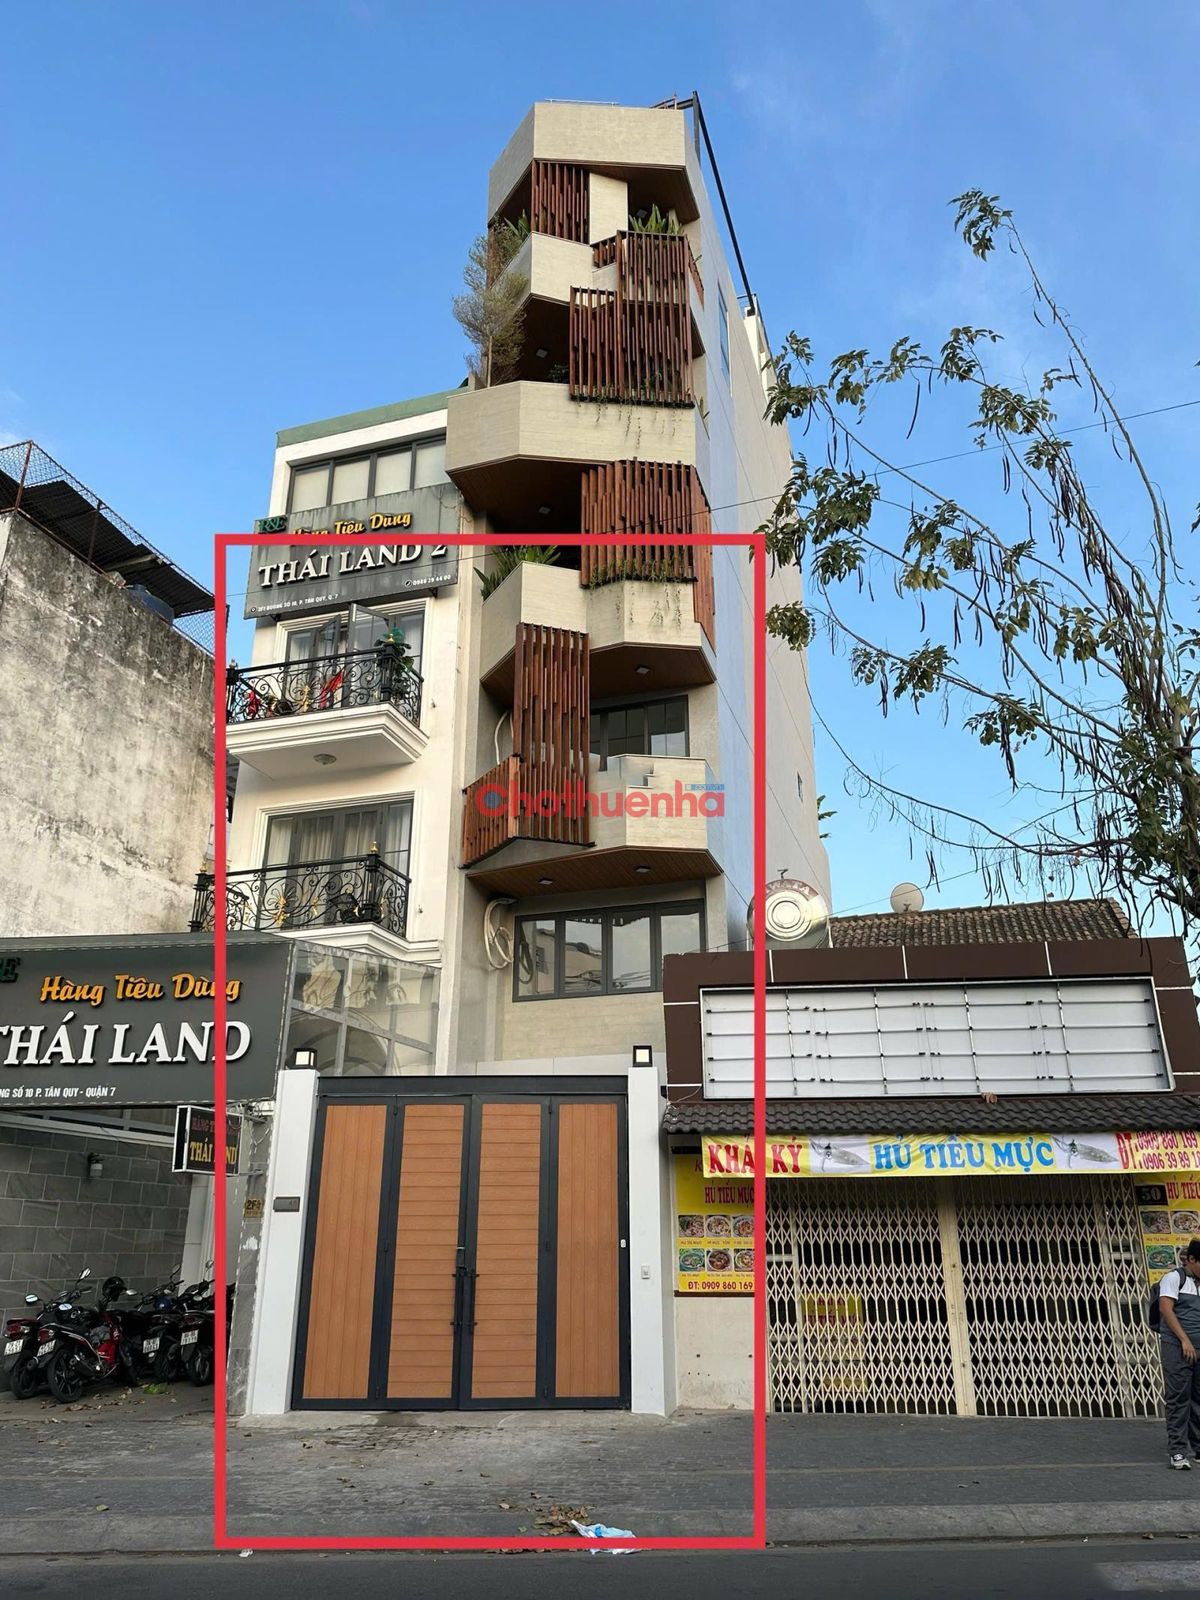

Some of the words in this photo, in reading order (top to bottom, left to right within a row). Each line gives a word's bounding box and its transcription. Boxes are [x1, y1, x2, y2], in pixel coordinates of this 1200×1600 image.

[258, 549, 331, 587] THÁI
[339, 545, 422, 573] LAND
[40, 974, 104, 1007] Hàng
[115, 973, 163, 1000] Tiêu
[108, 1021, 251, 1065] LAND
[110, 1086, 116, 1097] 7
[190, 1137, 213, 1162] THÁI
[992, 1137, 1055, 1173] MỰC
[1143, 1152, 1165, 1170] 0906
[1165, 1152, 1178, 1169] 39
[1178, 1151, 1191, 1168] 89
[688, 1281, 700, 1290] ĐT:
[701, 1281, 720, 1290] 0909
[722, 1281, 737, 1290] 860
[739, 1281, 753, 1290] 169
